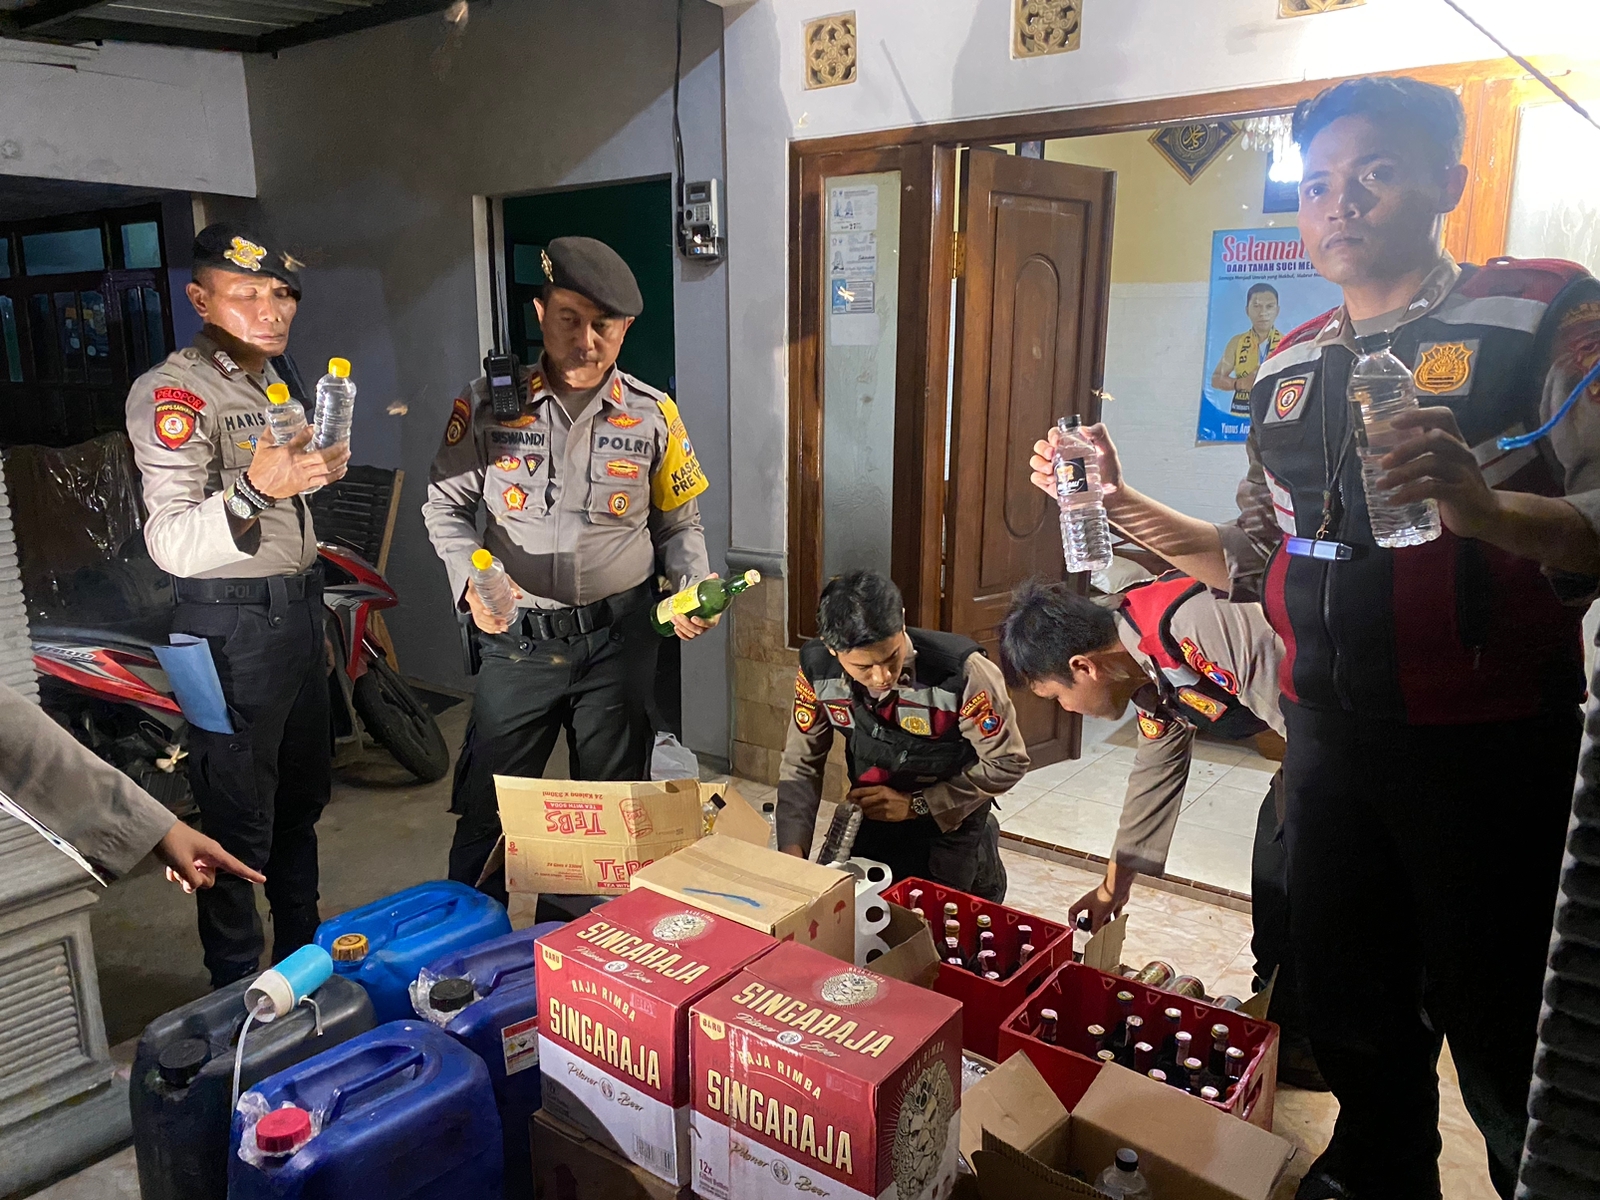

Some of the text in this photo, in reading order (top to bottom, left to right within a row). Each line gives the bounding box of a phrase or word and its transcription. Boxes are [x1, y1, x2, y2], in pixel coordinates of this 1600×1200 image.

[1226, 264, 1246, 273] DARI
[1248, 263, 1275, 272] TANAH
[1276, 262, 1296, 271] SUCI
[157, 389, 202, 408] PELOPOR
[225, 412, 266, 431] HARIS
[1221, 422, 1239, 434] Yunus
[598, 436, 651, 455] POLRI
[544, 949, 561, 965] BARU
[576, 921, 711, 985] SINGARAJA
[571, 979, 598, 996] RAJA
[602, 984, 637, 1023] RIMBA
[702, 1017, 722, 1034] BARU
[731, 981, 896, 1059] SINGARAJA
[549, 997, 661, 1091] SINGARAJA
[736, 1050, 772, 1070] RAJA
[777, 1060, 822, 1100] RIMBA
[567, 1061, 645, 1113] Pilsner Beer
[707, 1069, 853, 1175] SINGARAJA
[699, 1158, 713, 1177] 12x
[794, 1175, 831, 1198] Beer
